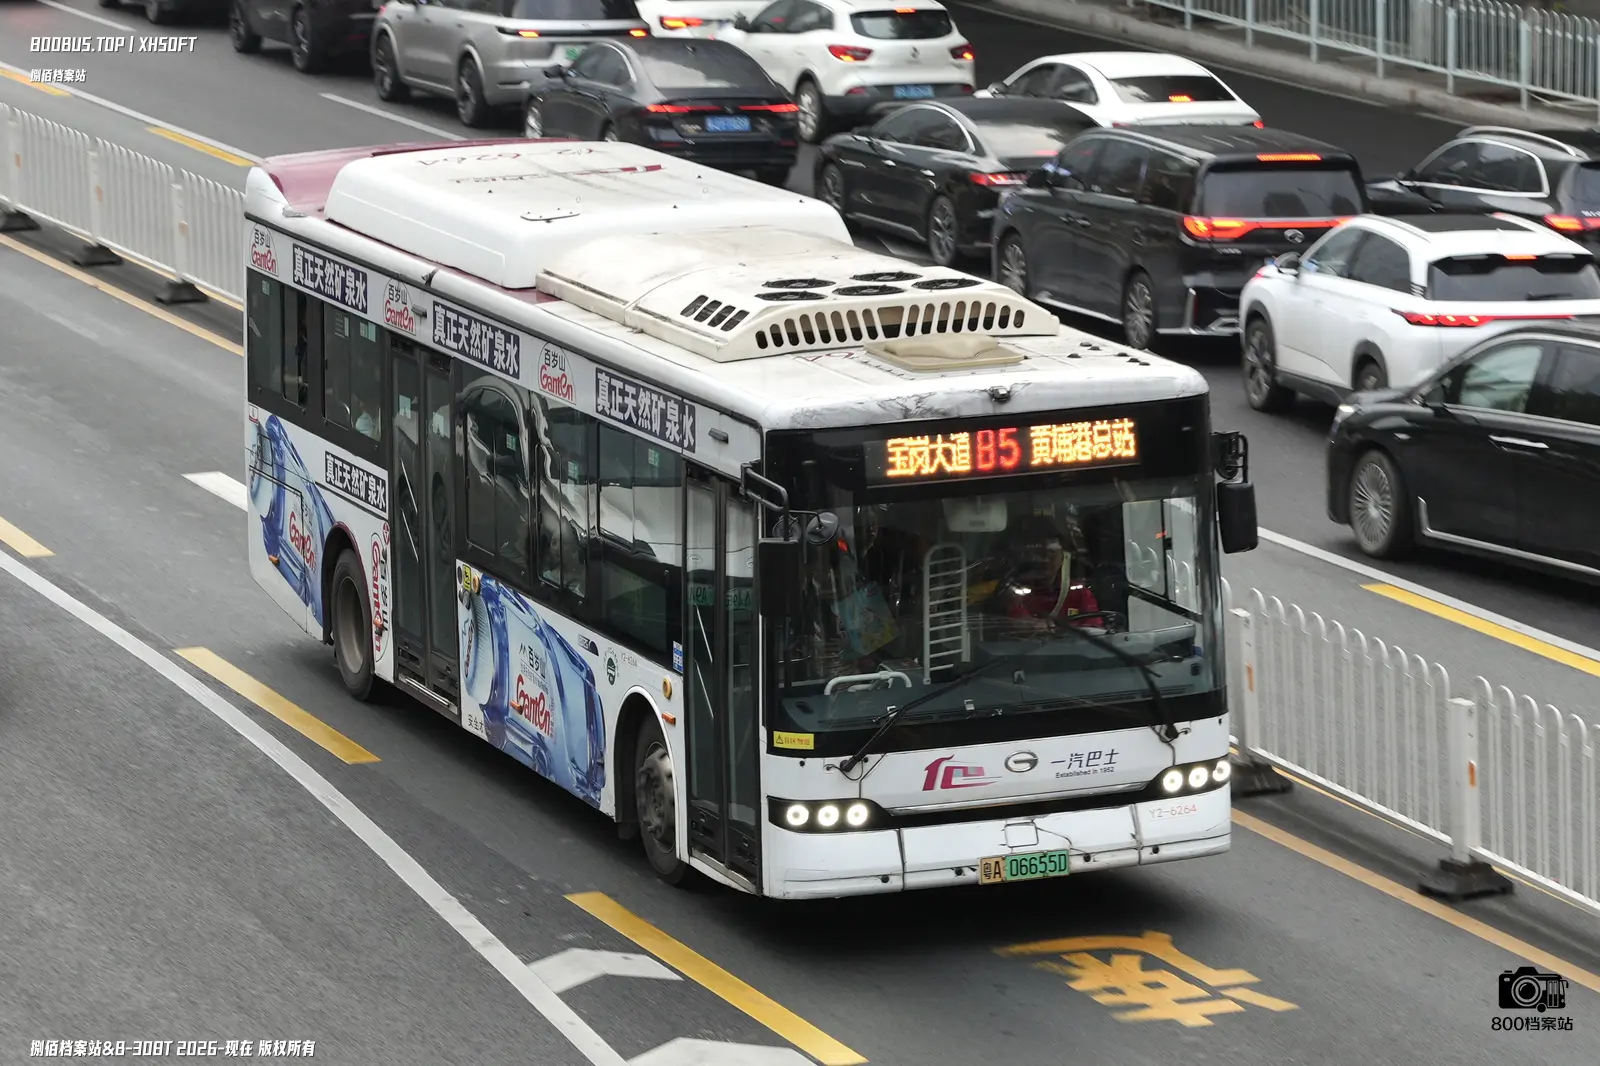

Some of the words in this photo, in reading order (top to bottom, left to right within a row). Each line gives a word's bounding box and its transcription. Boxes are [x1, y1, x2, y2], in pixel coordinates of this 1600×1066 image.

[254, 228, 271, 249] 百岁山
[293, 247, 367, 310] 真正天然矿泉水
[388, 284, 408, 306] 百岁山
[384, 299, 414, 333] Ganten
[433, 304, 519, 376] 真正天然矿泉水
[543, 341, 566, 372] 百岁山
[539, 364, 573, 402] Ganten
[596, 371, 696, 449] 真正天然矿泉水
[886, 431, 972, 477] 宝岗大道
[1029, 417, 1137, 465] 黄埔港总站
[325, 453, 387, 510] 真正天然矿泉水
[1050, 748, 1120, 770] 一汽巴士
[1148, 803, 1197, 819] Y2-6264
[1009, 853, 1068, 877] 06655D
